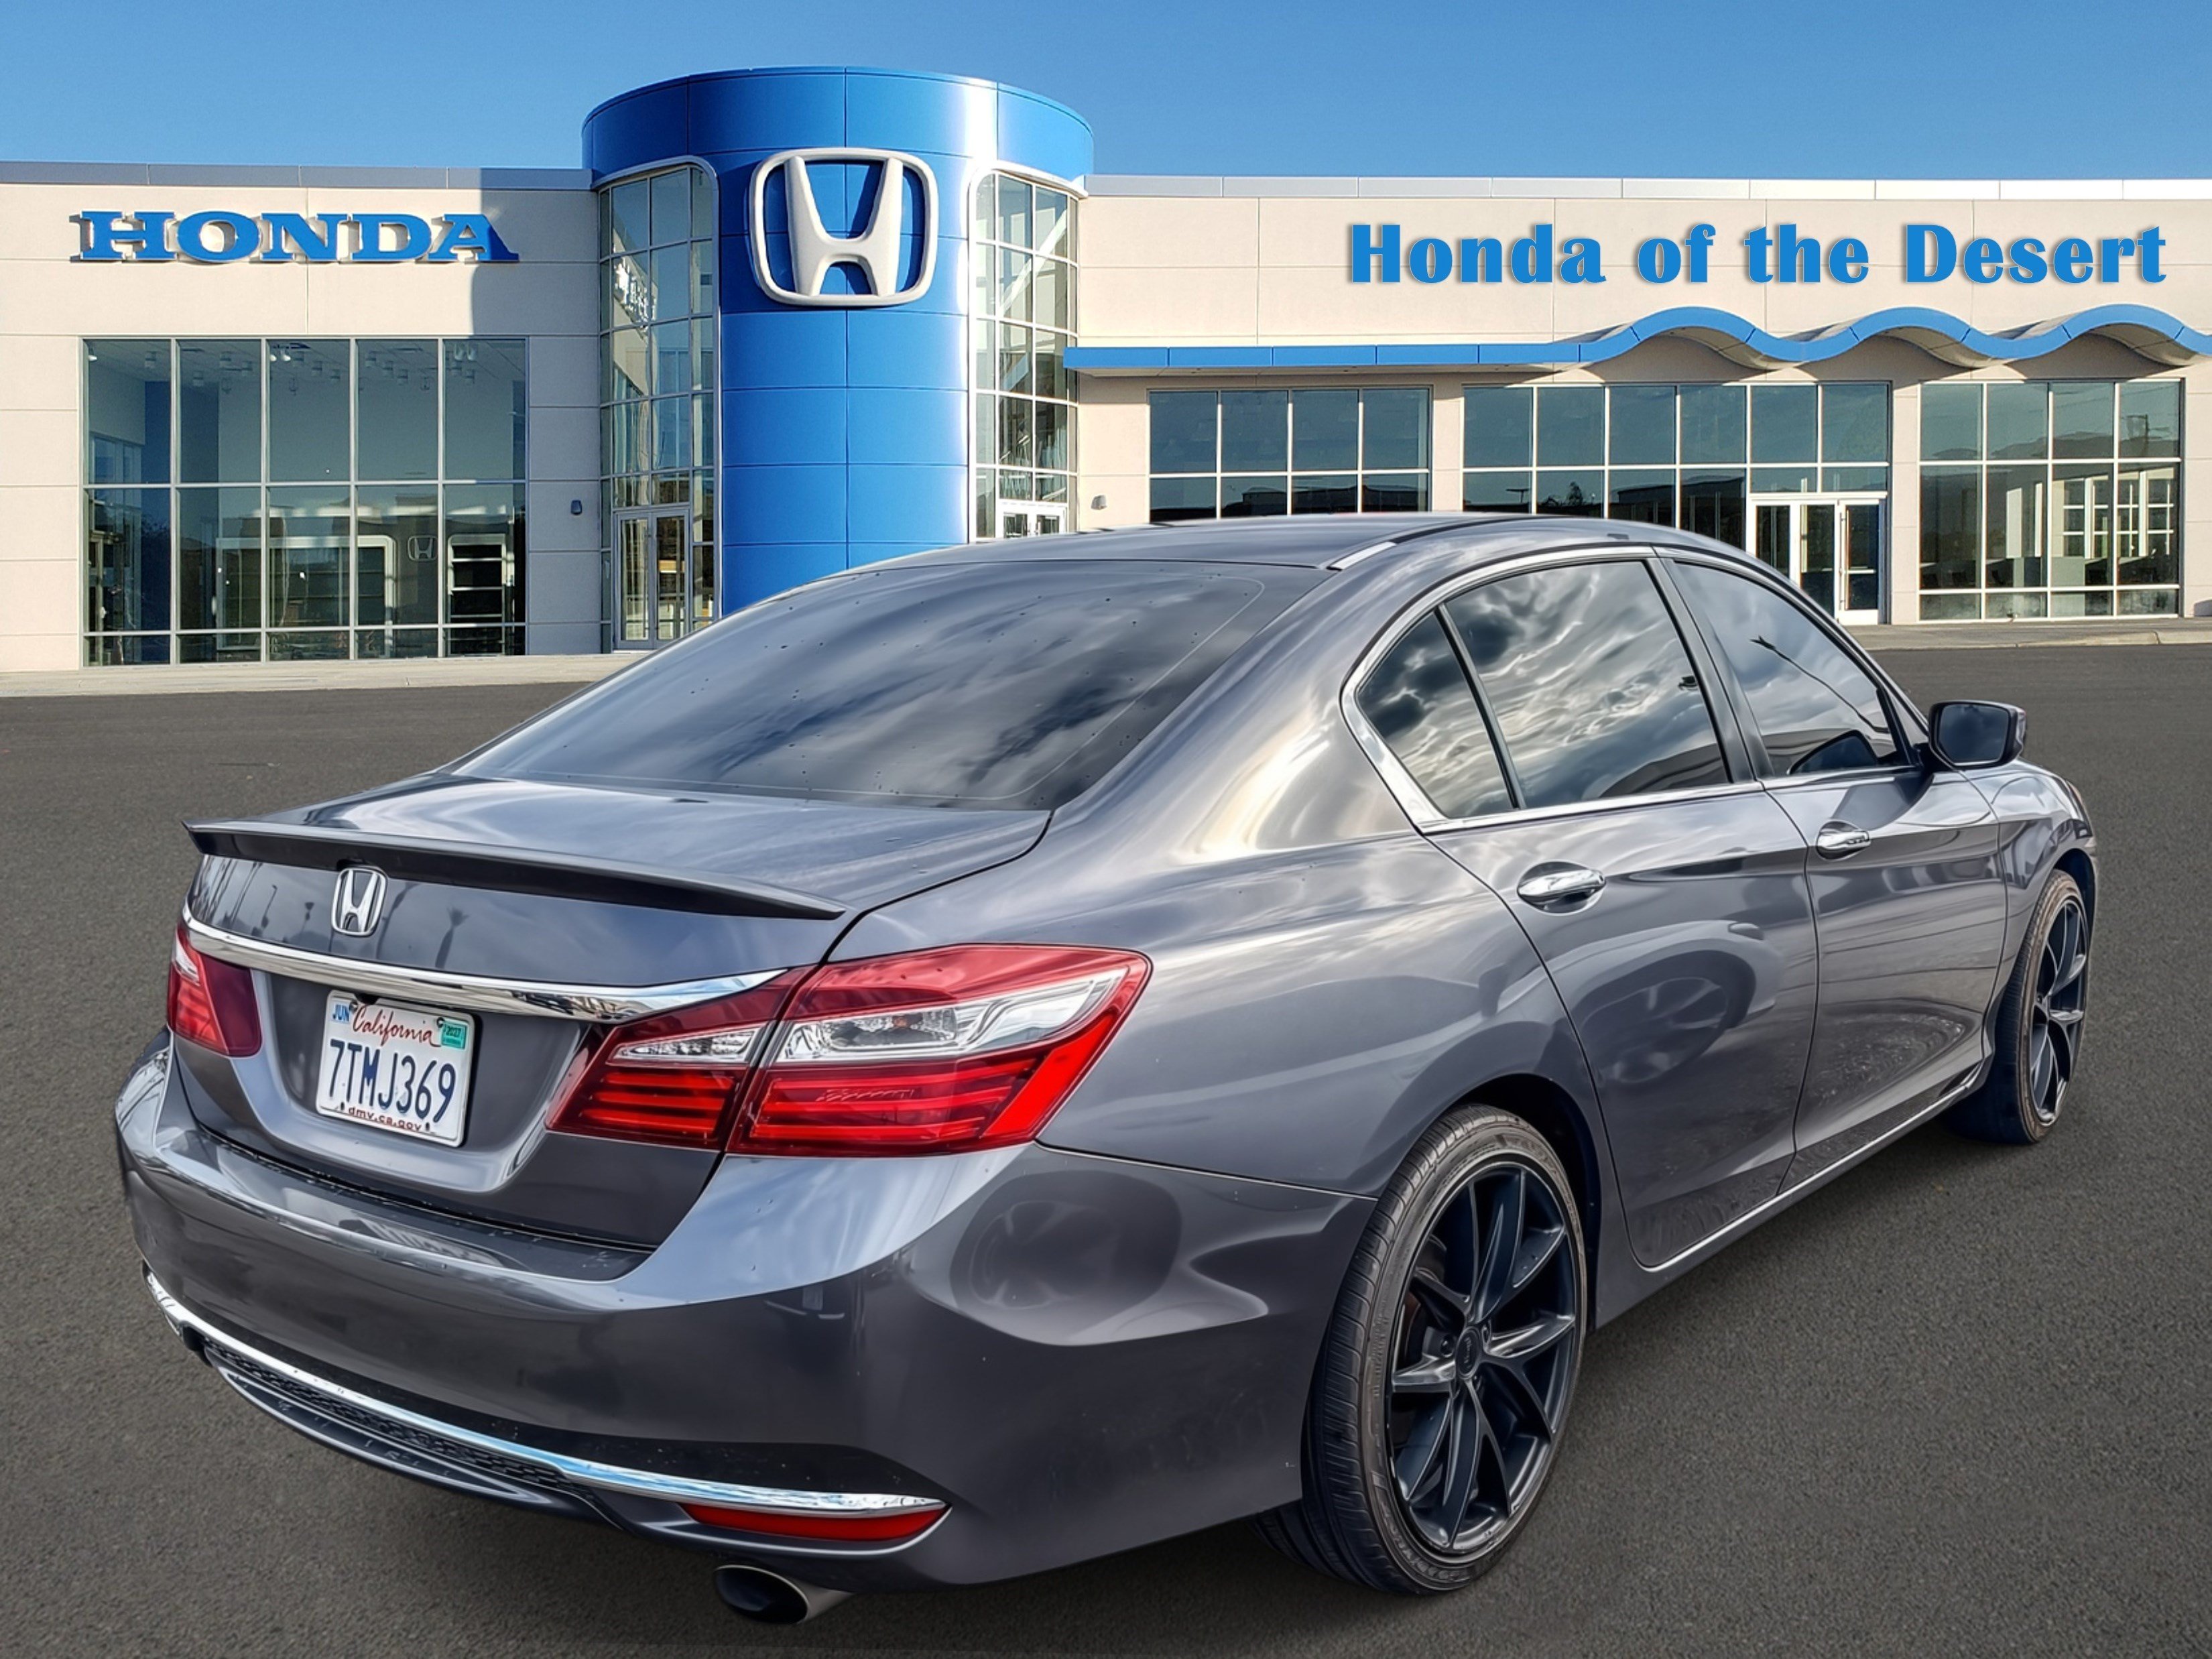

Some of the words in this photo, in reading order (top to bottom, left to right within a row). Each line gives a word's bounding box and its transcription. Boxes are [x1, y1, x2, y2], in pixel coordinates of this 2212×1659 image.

[80, 210, 519, 261] HONDA
[1351, 224, 1605, 284] Honda
[1638, 224, 1716, 284] of
[1744, 224, 1869, 284] the
[1906, 224, 2166, 284] Desert
[332, 1004, 350, 1022] JUN
[351, 1005, 442, 1047] California
[329, 1038, 457, 1123] 7TMJ369
[347, 1107, 423, 1131] dmv.ca.gov
